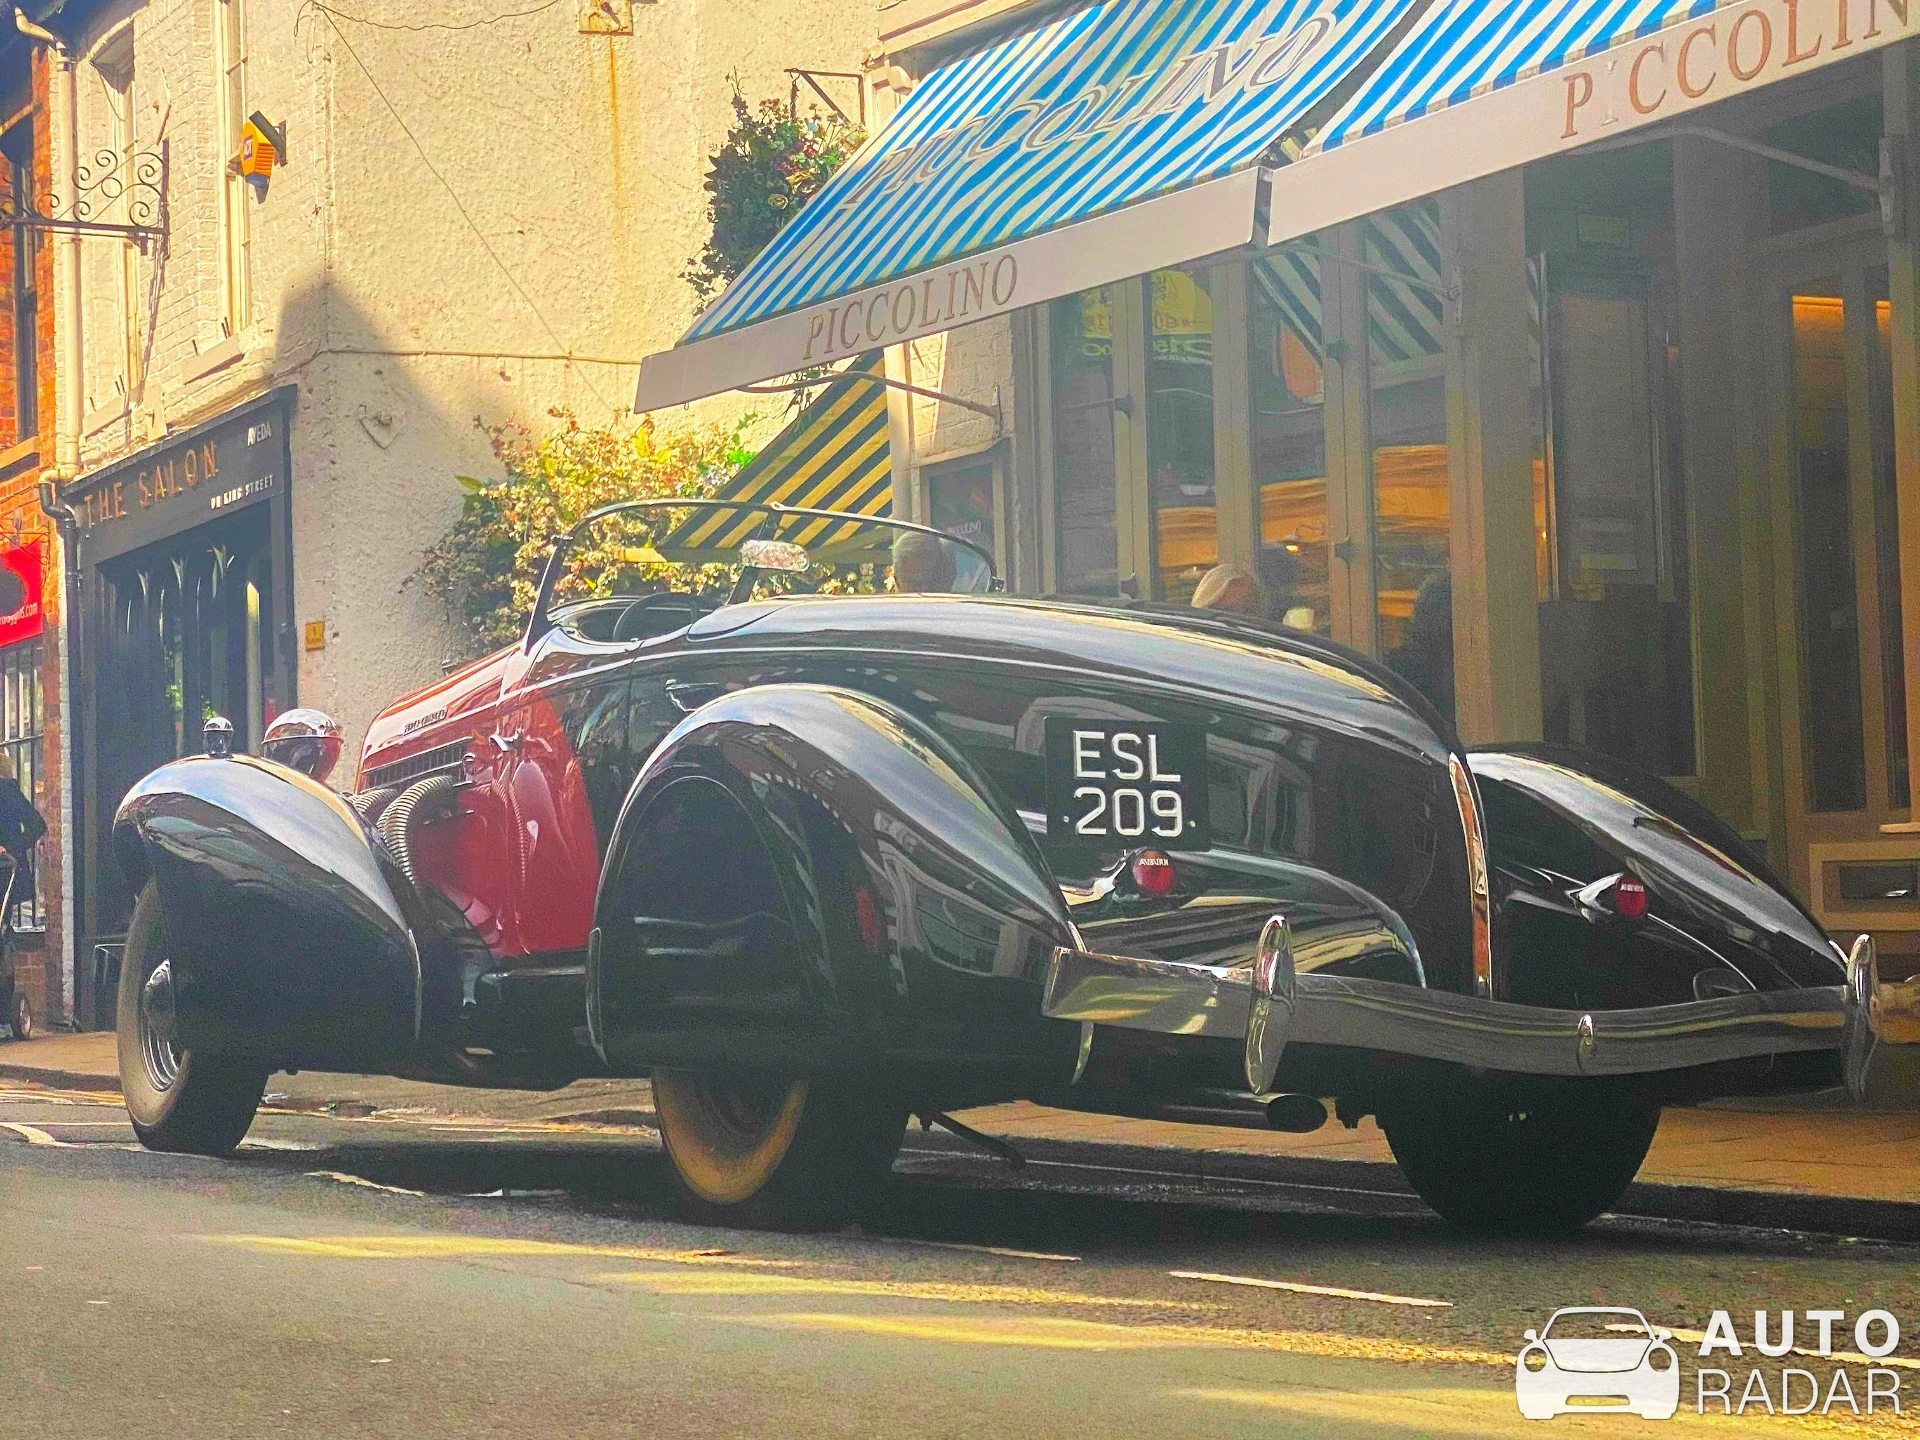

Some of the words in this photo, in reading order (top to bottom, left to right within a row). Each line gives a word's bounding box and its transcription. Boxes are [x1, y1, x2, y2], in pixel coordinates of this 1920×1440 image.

[842, 12, 1337, 210] PICCOLINO
[803, 254, 1018, 360] PICCOLINO
[247, 420, 272, 447] AVEDA
[84, 481, 127, 528] THE
[139, 441, 220, 509] SALON
[245, 474, 274, 497] STREET
[1073, 730, 1181, 783] ESL
[1073, 786, 1183, 837] 209
[1139, 858, 1169, 866] AUBURN
